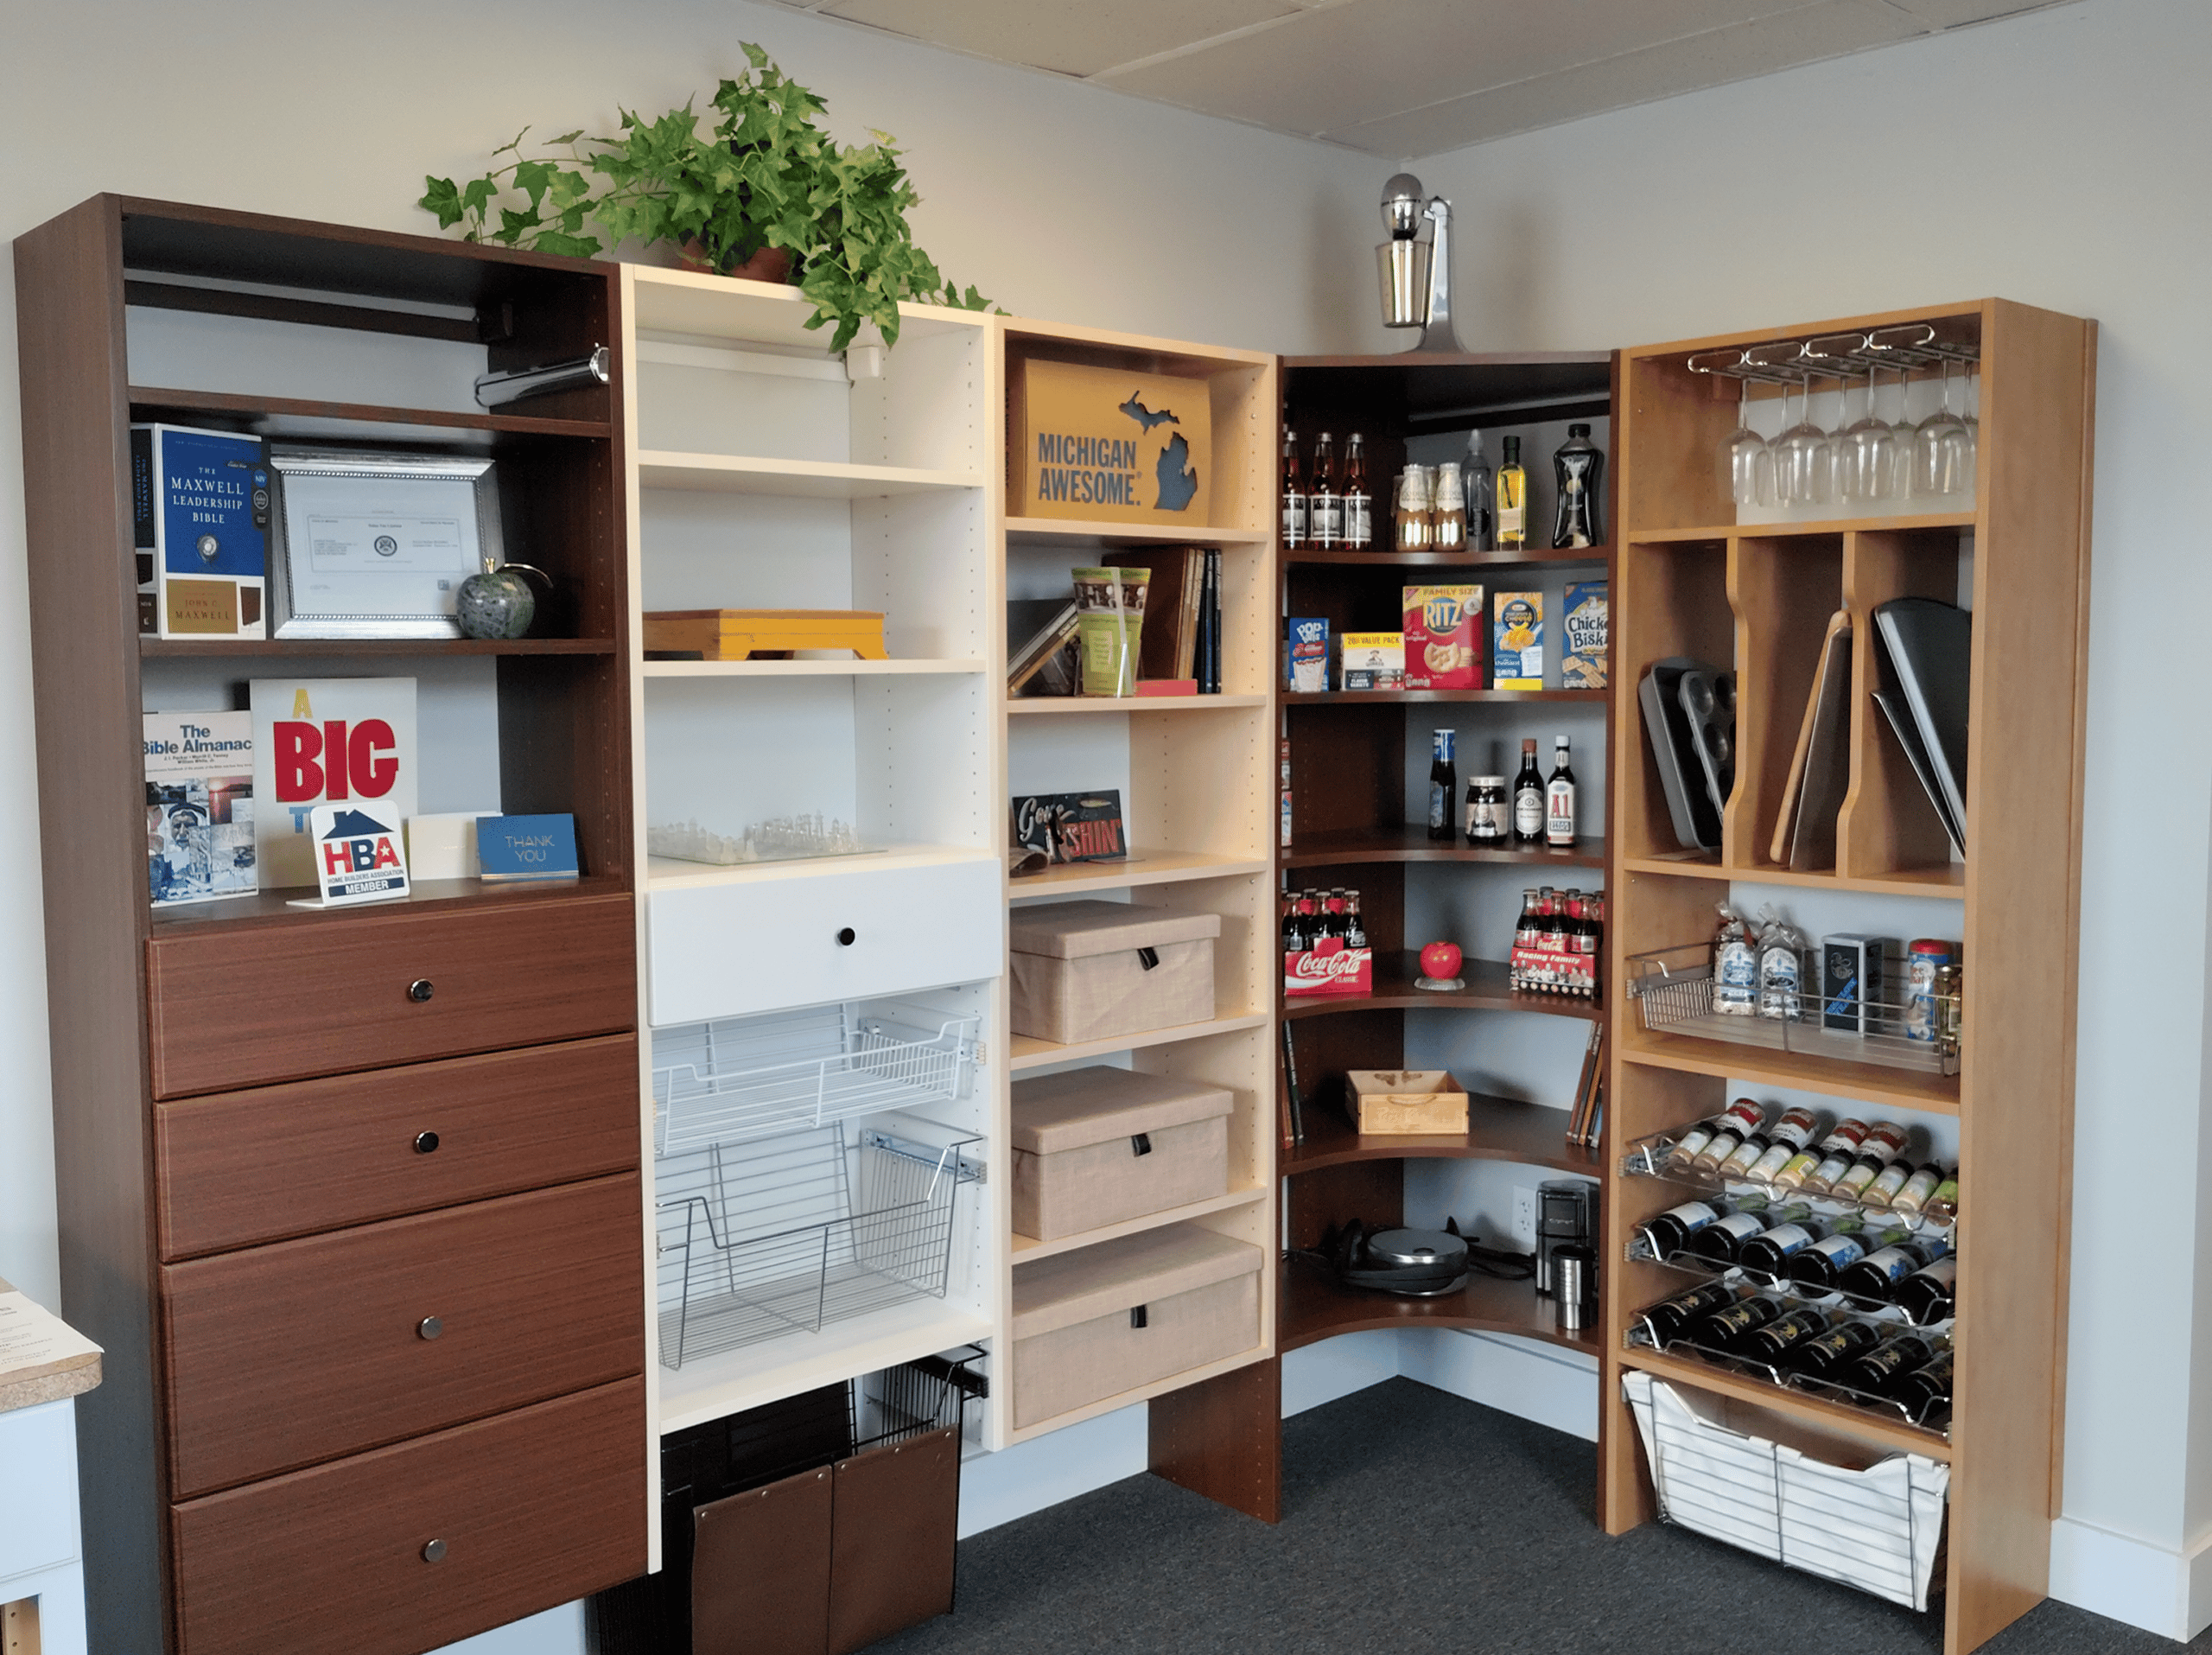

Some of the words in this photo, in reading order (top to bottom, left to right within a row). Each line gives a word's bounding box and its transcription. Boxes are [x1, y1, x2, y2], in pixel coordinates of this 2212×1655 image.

[1039, 432, 1136, 469] MICHIGAN
[198, 467, 216, 475] THE
[171, 476, 245, 496] MAXWELL
[173, 495, 243, 510] LEADERSHIP
[193, 512, 225, 524] BIBLE
[175, 610, 230, 621] MAXWELL
[1423, 602, 1463, 627] RITZ
[1382, 635, 1400, 645] PACK
[292, 689, 313, 719] A
[180, 724, 210, 738] The
[183, 739, 252, 754] Almanac
[273, 718, 399, 803] BIG
[505, 835, 555, 848] THANK
[323, 837, 401, 875] HBA
[514, 850, 546, 863] YOU
[345, 873, 370, 882] BUILDERS
[370, 869, 404, 878] ASSOCIATION
[346, 880, 389, 894] MEMBER
[1516, 951, 1548, 962] Racing
[1550, 954, 1580, 964] Family
